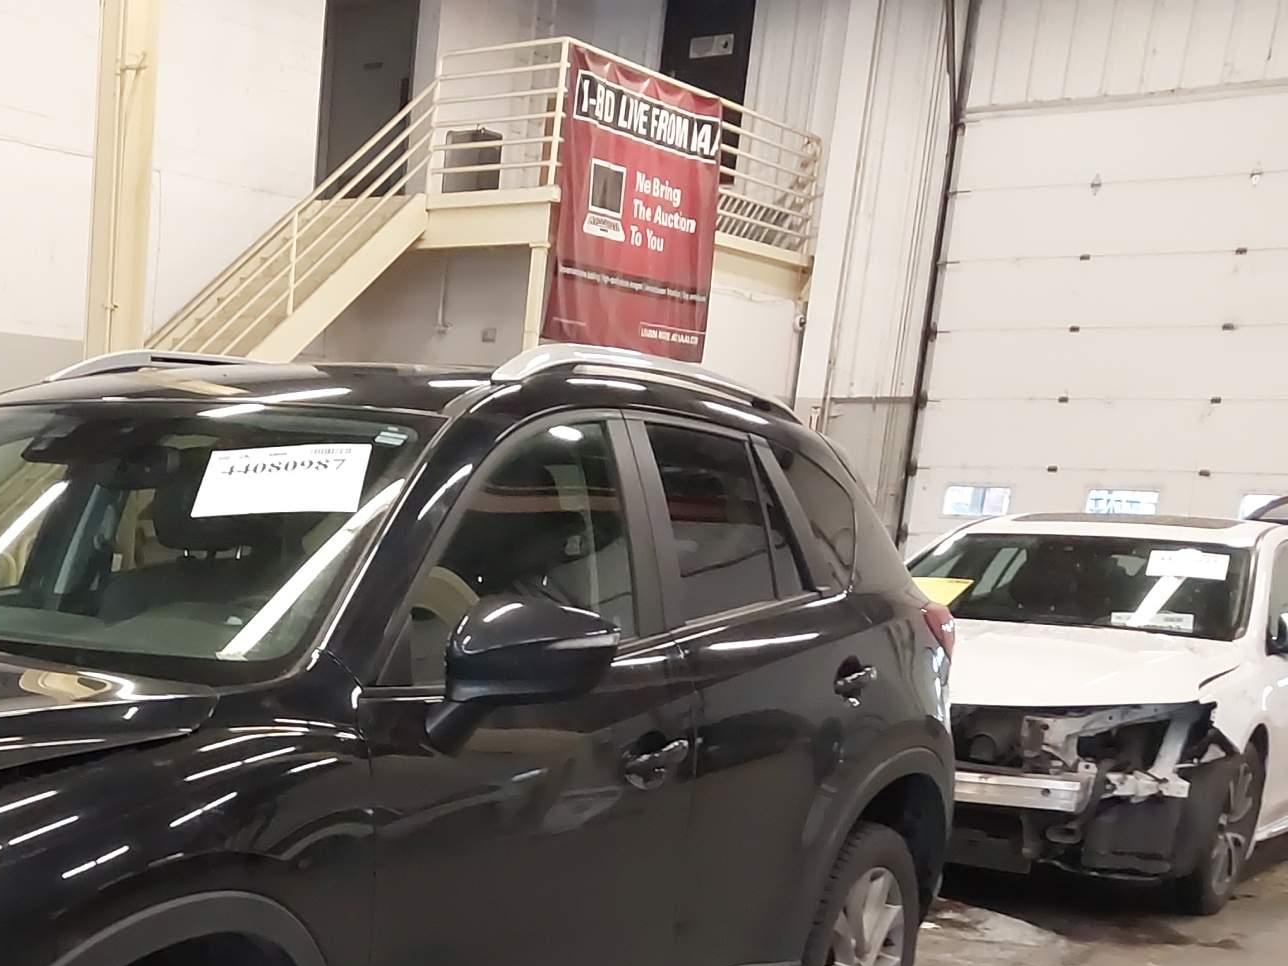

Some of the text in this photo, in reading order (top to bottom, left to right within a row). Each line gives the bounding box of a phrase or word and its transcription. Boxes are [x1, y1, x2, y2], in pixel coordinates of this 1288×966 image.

[617, 94, 651, 136] LIVE
[650, 106, 690, 150] FROM
[652, 177, 682, 208] Bring
[633, 198, 697, 234] The Auction
[630, 224, 665, 252] To You
